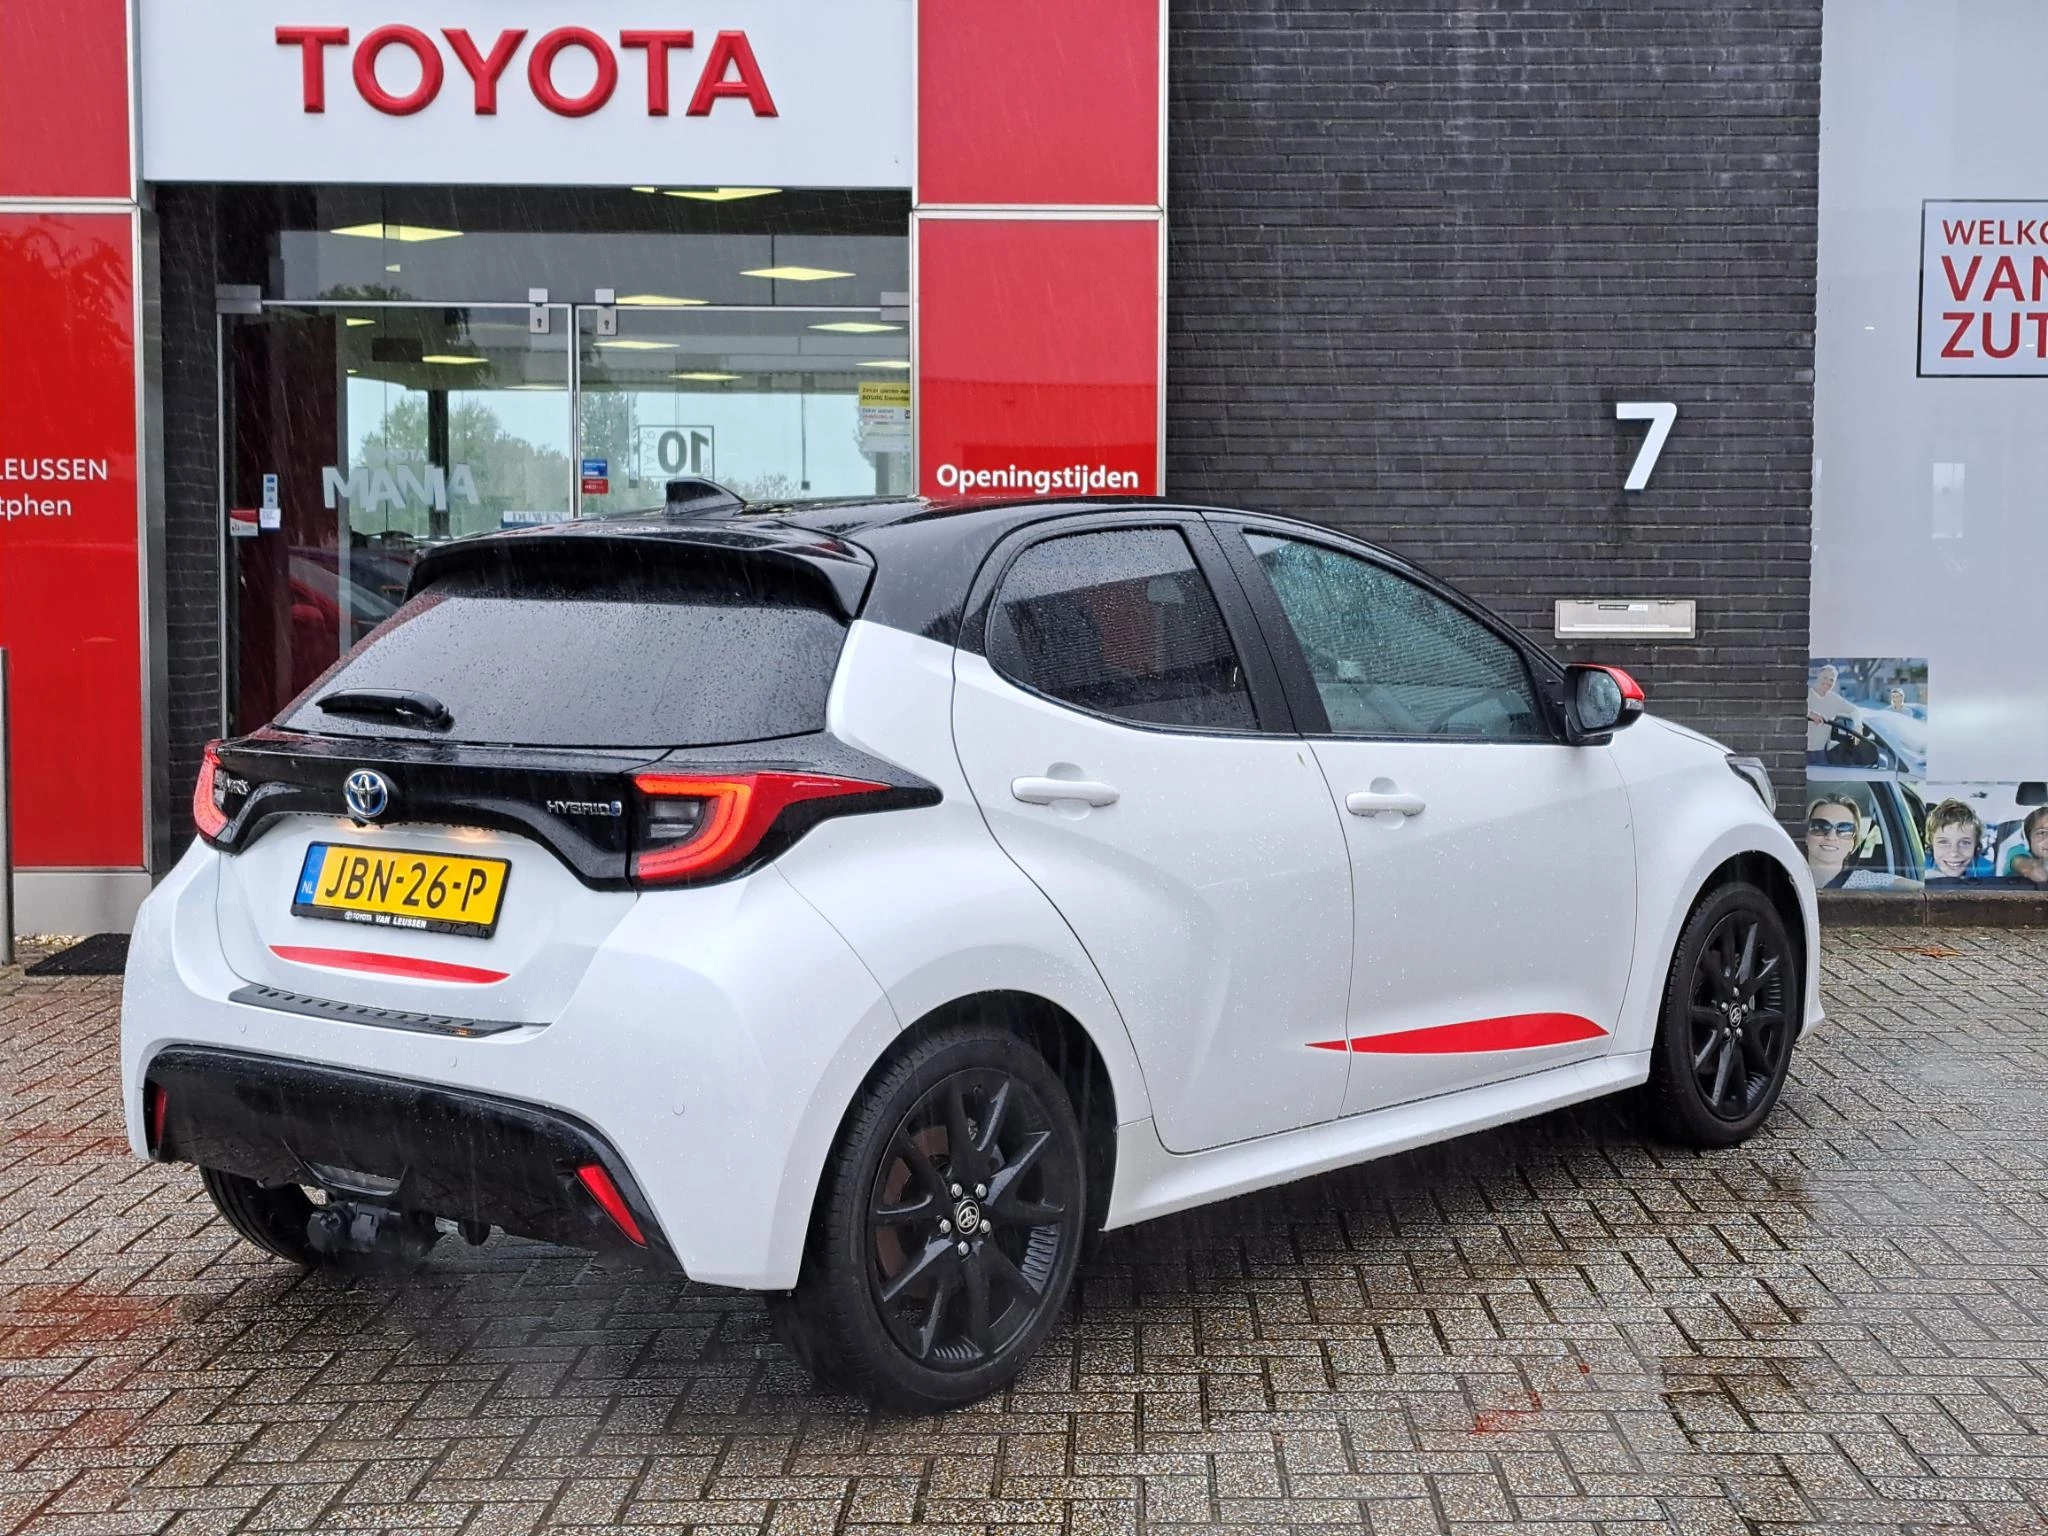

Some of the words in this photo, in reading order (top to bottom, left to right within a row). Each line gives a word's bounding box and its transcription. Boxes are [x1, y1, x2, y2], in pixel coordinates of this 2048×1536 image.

[275, 24, 779, 118] TOYOTA
[1616, 402, 1678, 490] 7
[0, 458, 107, 481] EUSSEN
[322, 463, 480, 513] MANIA
[936, 464, 1139, 494] Openingstijden
[546, 800, 610, 816] HYBRID
[301, 881, 314, 895] NL
[324, 855, 488, 912] JBN-26-P
[352, 912, 373, 921] TOYOTA
[375, 914, 391, 924] VAN
[392, 916, 427, 929] LEUSSEN
